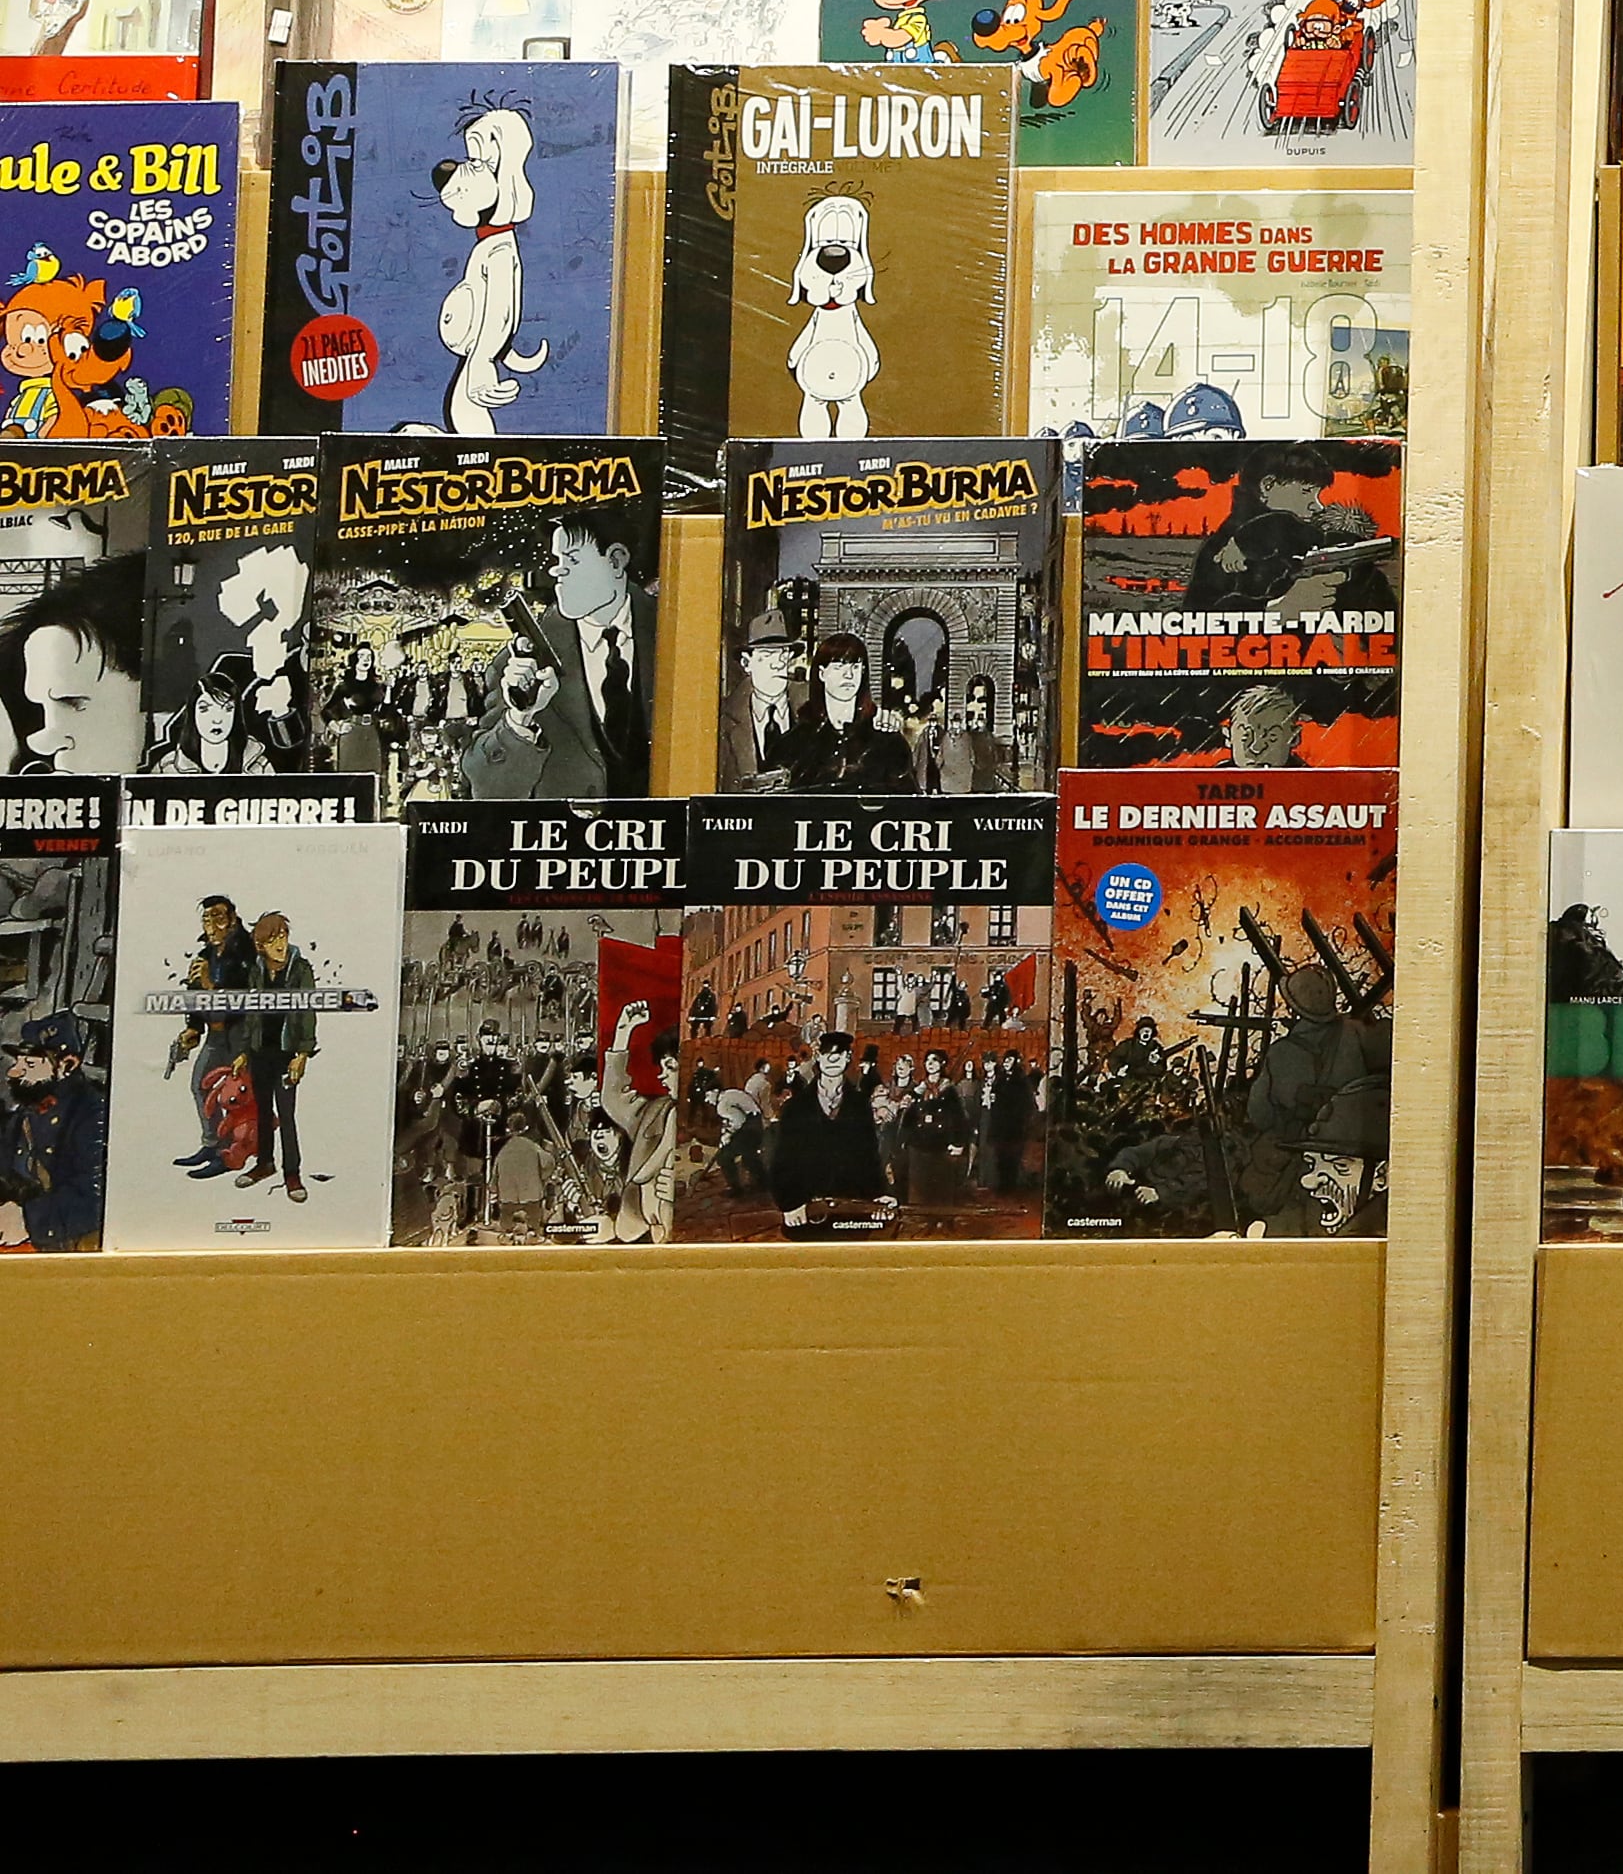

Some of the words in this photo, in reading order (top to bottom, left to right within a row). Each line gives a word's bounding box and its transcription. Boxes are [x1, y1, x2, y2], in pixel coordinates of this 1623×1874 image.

[741, 95, 982, 158] GAI-LURON
[130, 143, 220, 195] Bill
[757, 158, 834, 175] INTÉGRALE
[1072, 223, 1128, 246] DES
[1140, 222, 1252, 247] HOMMES
[1259, 226, 1312, 244] DANS
[1109, 257, 1136, 274] LA
[1144, 251, 1256, 274] GRANDE
[1268, 249, 1383, 273] GUERRE
[340, 463, 496, 523] NESTOR
[495, 457, 641, 508] BURMA
[747, 468, 894, 528] NESTOR
[895, 460, 1039, 512] BURMA
[703, 818, 753, 831] TARDI
[973, 818, 1043, 831] VAUTRIN
[1074, 806, 1110, 829] LE
[1119, 805, 1256, 828] DERNIER
[1266, 805, 1387, 829] ASSAUT
[795, 821, 852, 852] LE
[870, 821, 951, 852] CRI
[735, 859, 805, 890] DU
[821, 859, 1008, 890] PEUPLE
[1067, 1217, 1121, 1227] casterman
